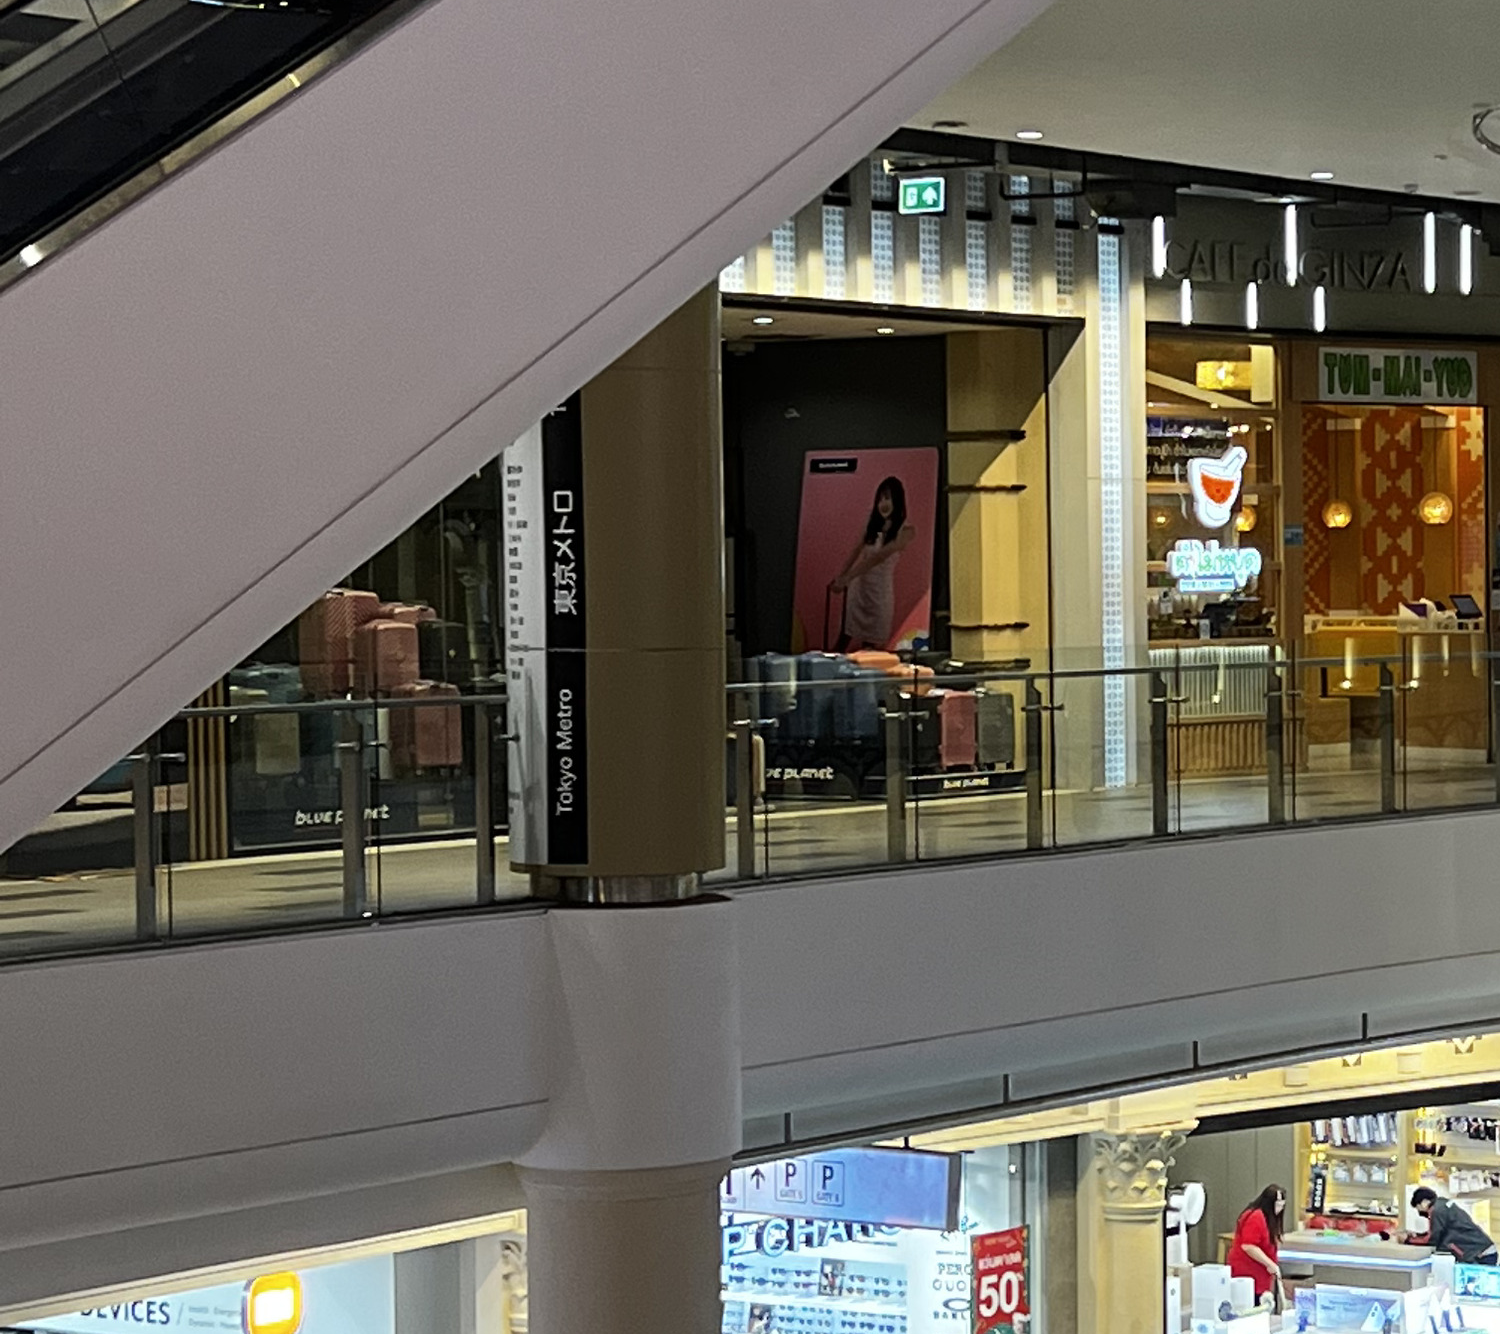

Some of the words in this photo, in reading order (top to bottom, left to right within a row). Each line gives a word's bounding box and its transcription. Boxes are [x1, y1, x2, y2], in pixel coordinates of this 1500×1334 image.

[552, 490, 579, 615] 東京メトロ
[556, 688, 574, 750] Metro
[555, 756, 574, 817] Tokyo
[335, 803, 391, 825] pnet
[784, 1162, 797, 1188] P
[821, 1164, 835, 1191] P
